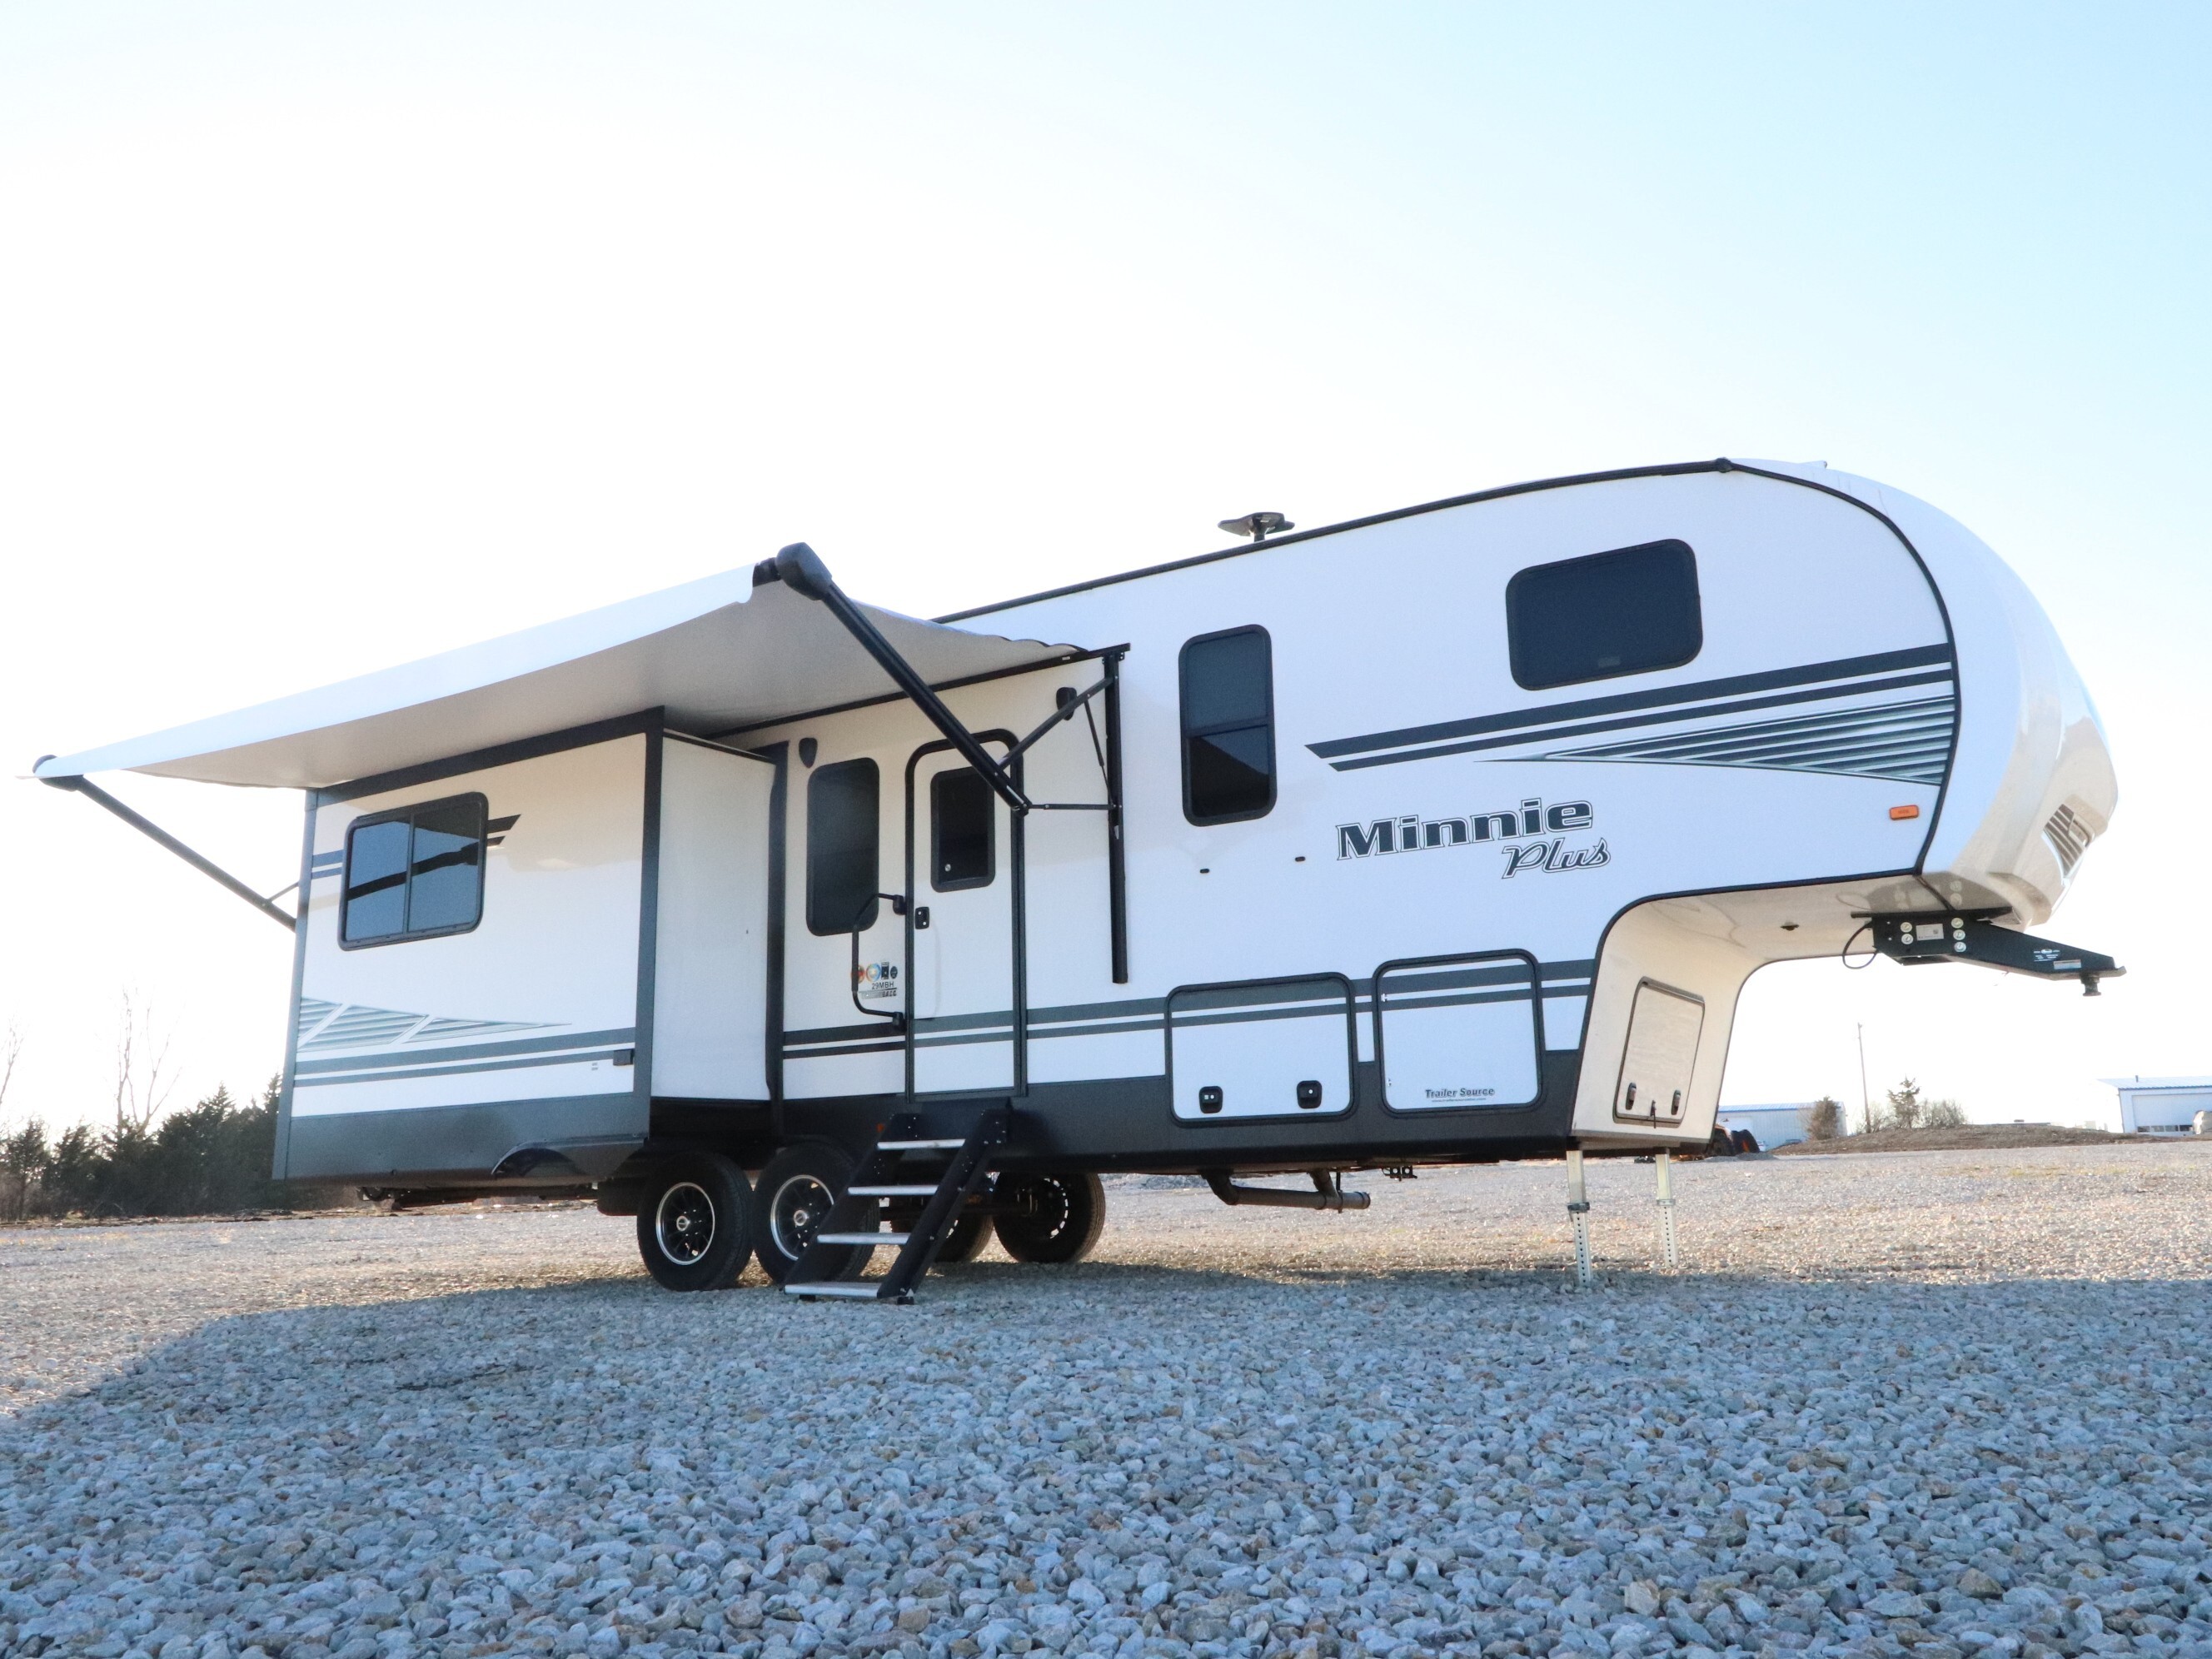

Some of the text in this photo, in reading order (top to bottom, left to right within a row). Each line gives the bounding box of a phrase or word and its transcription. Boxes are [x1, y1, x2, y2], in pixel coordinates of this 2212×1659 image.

[1335, 797, 1593, 861] Minnie
[1502, 837, 1612, 879] Plus
[871, 981, 894, 989] 29MBH
[1425, 1088, 1495, 1099] Trailer Source
